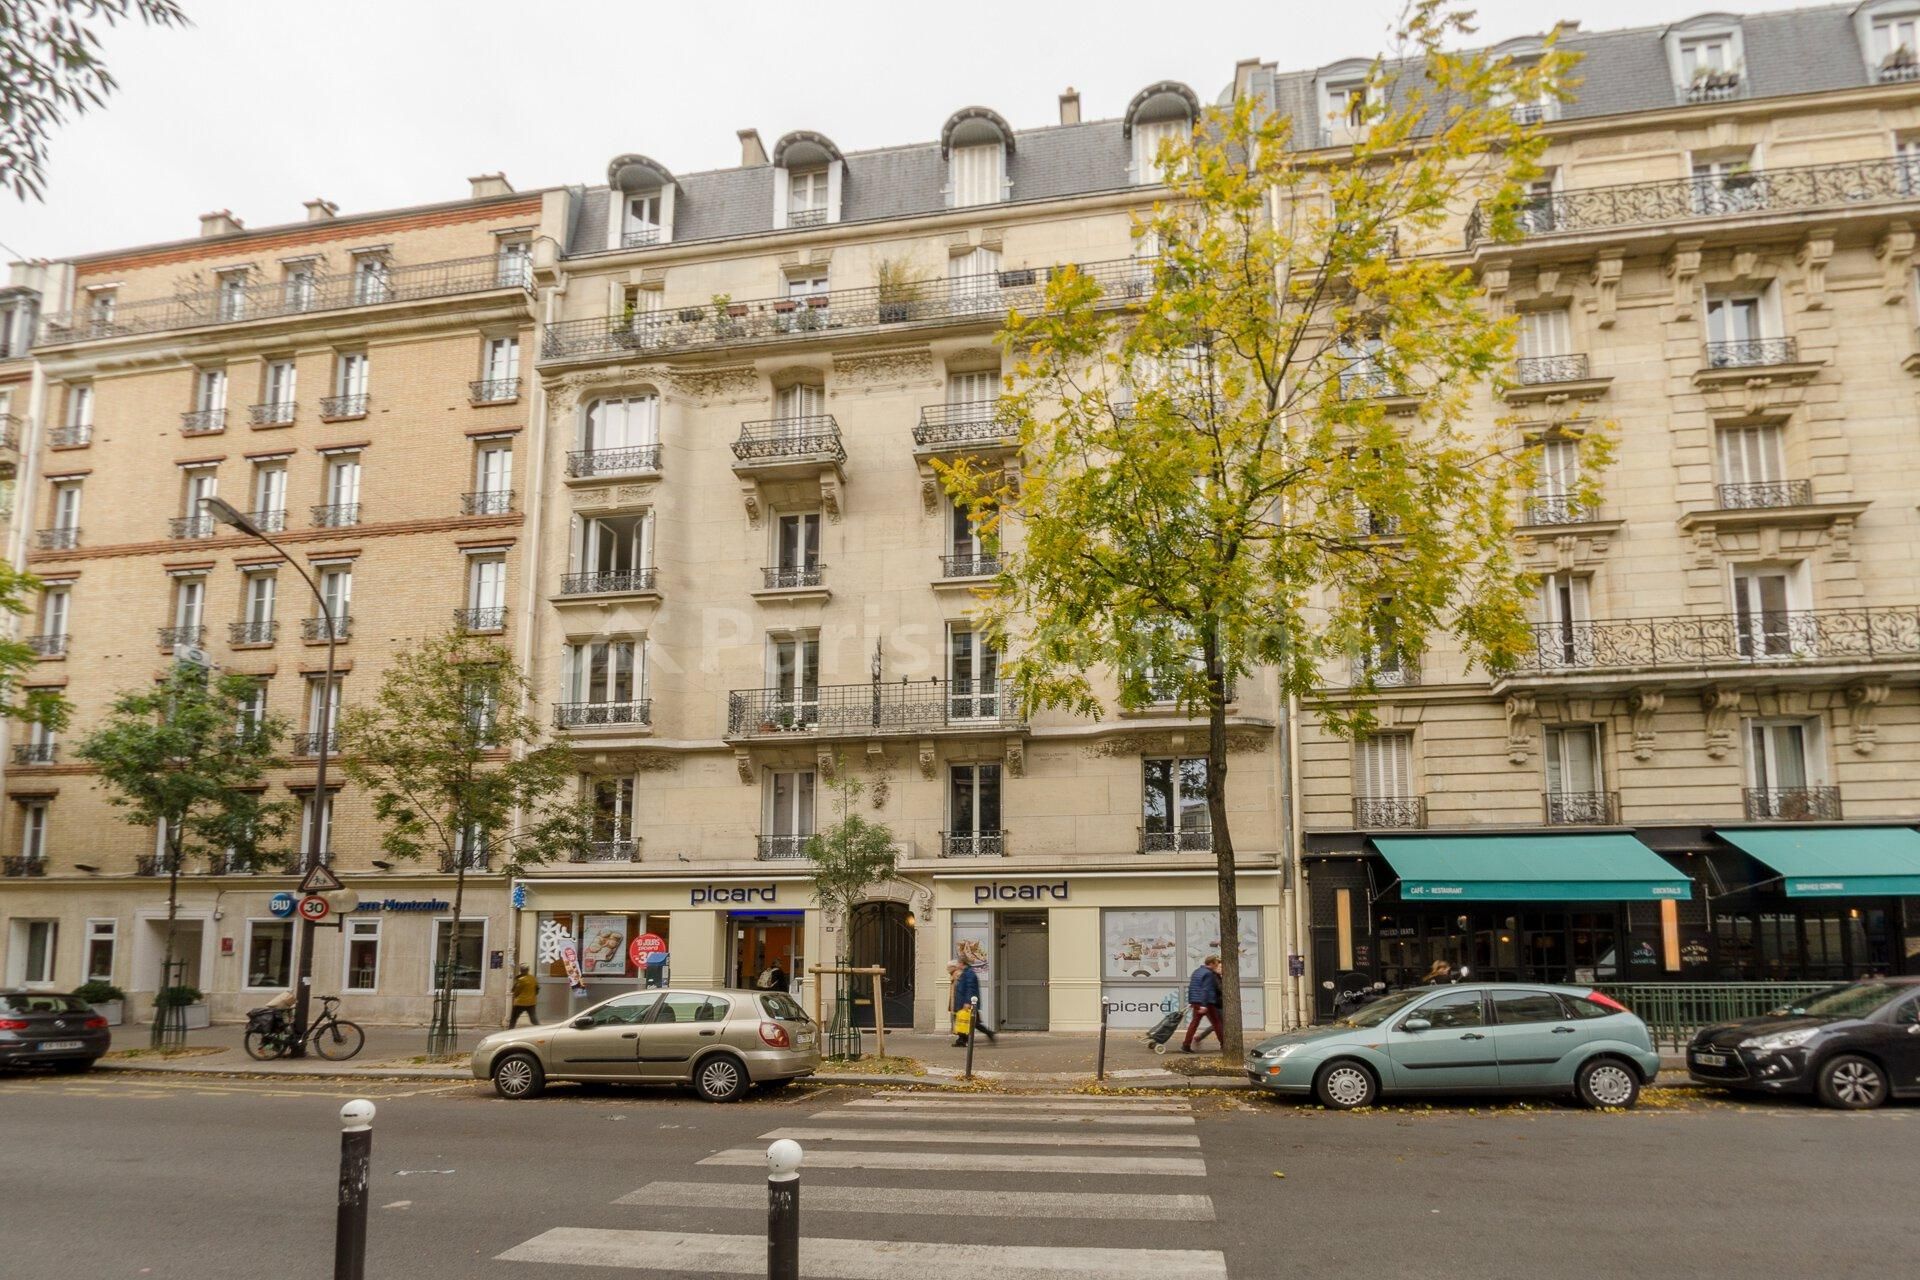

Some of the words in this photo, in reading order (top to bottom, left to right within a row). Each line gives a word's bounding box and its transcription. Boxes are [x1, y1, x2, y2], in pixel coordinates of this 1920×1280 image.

[690, 883, 776, 906] picard
[975, 880, 1068, 904] picard
[271, 899, 290, 911] BW
[304, 902, 324, 913] 30
[1108, 1000, 1172, 1015] picard
